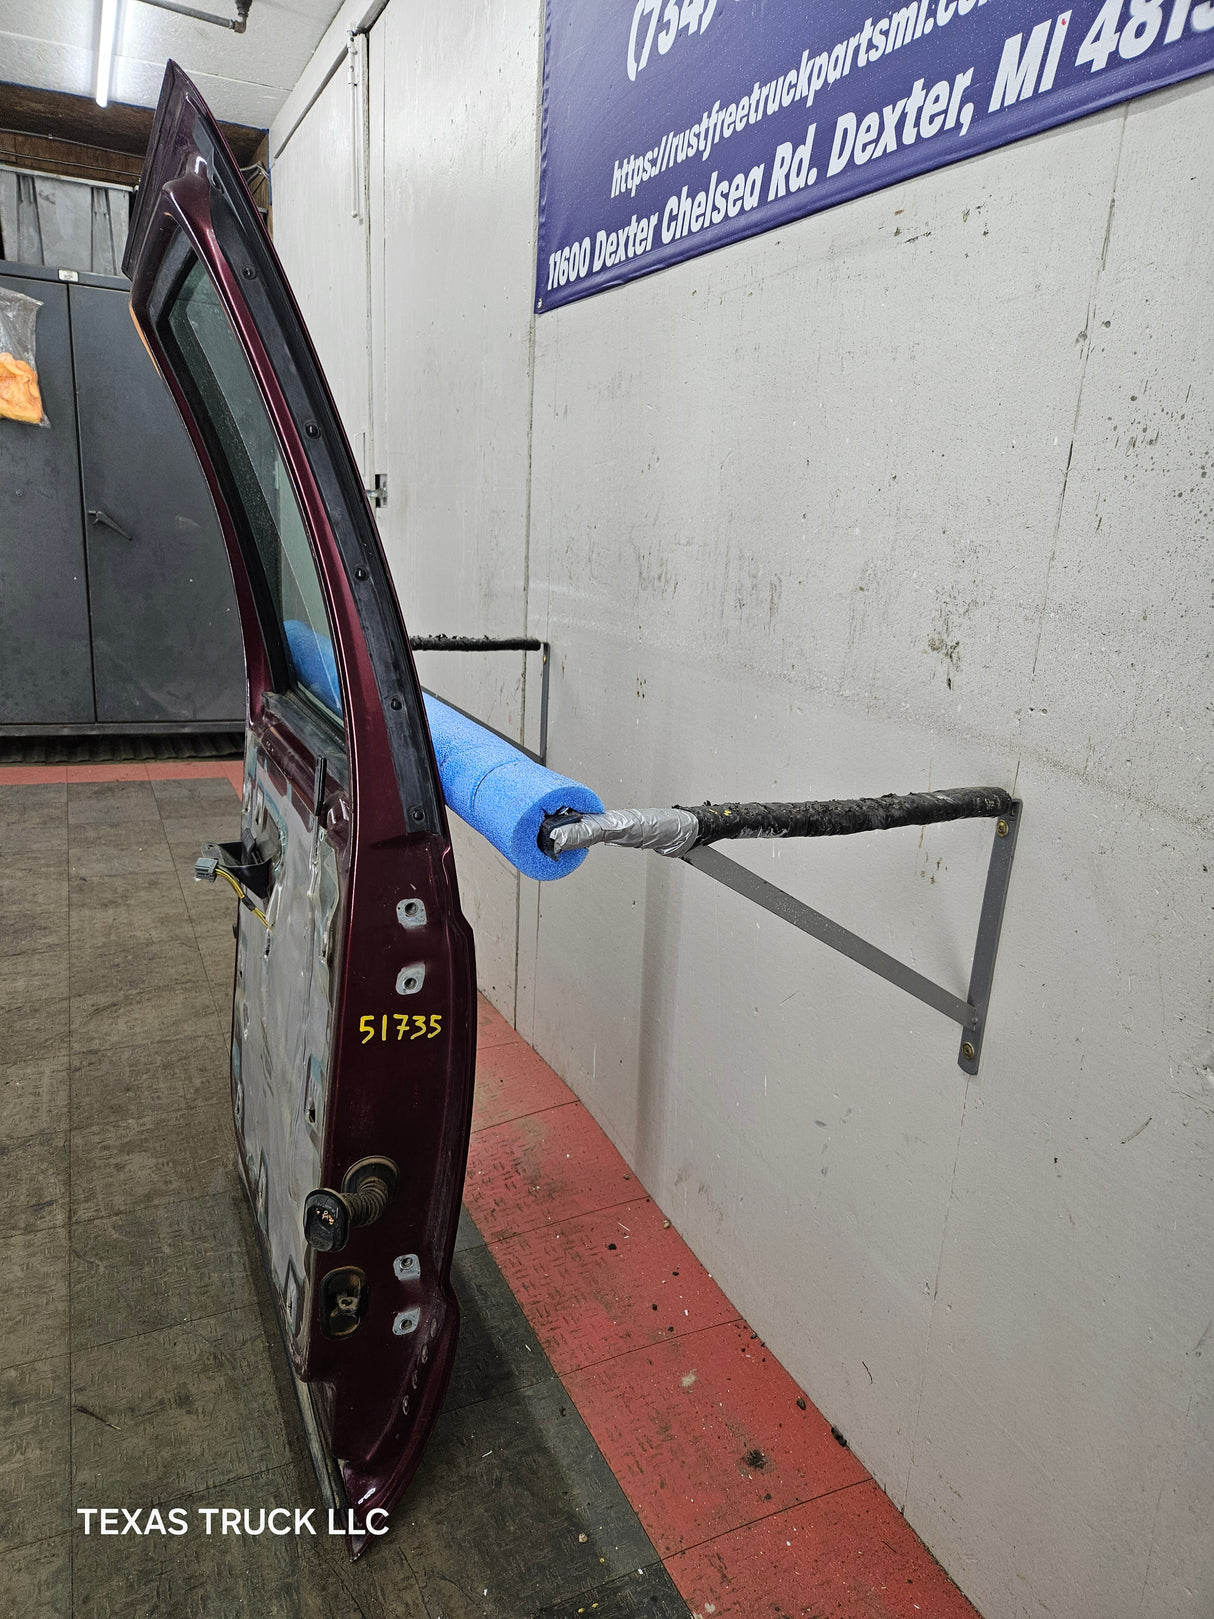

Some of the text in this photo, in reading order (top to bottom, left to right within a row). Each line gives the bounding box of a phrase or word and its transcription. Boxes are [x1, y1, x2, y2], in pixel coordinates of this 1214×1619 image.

[547, 237, 591, 290] 11600
[593, 212, 659, 272] Dexter
[661, 163, 765, 244] Chelsea
[768, 123, 817, 202] Rd.
[827, 67, 975, 176] Dexter,
[988, 10, 1072, 113] MI
[610, 0, 987, 198] https://rustfreetruckpartsmi.c
[359, 1014, 442, 1044] 51735
